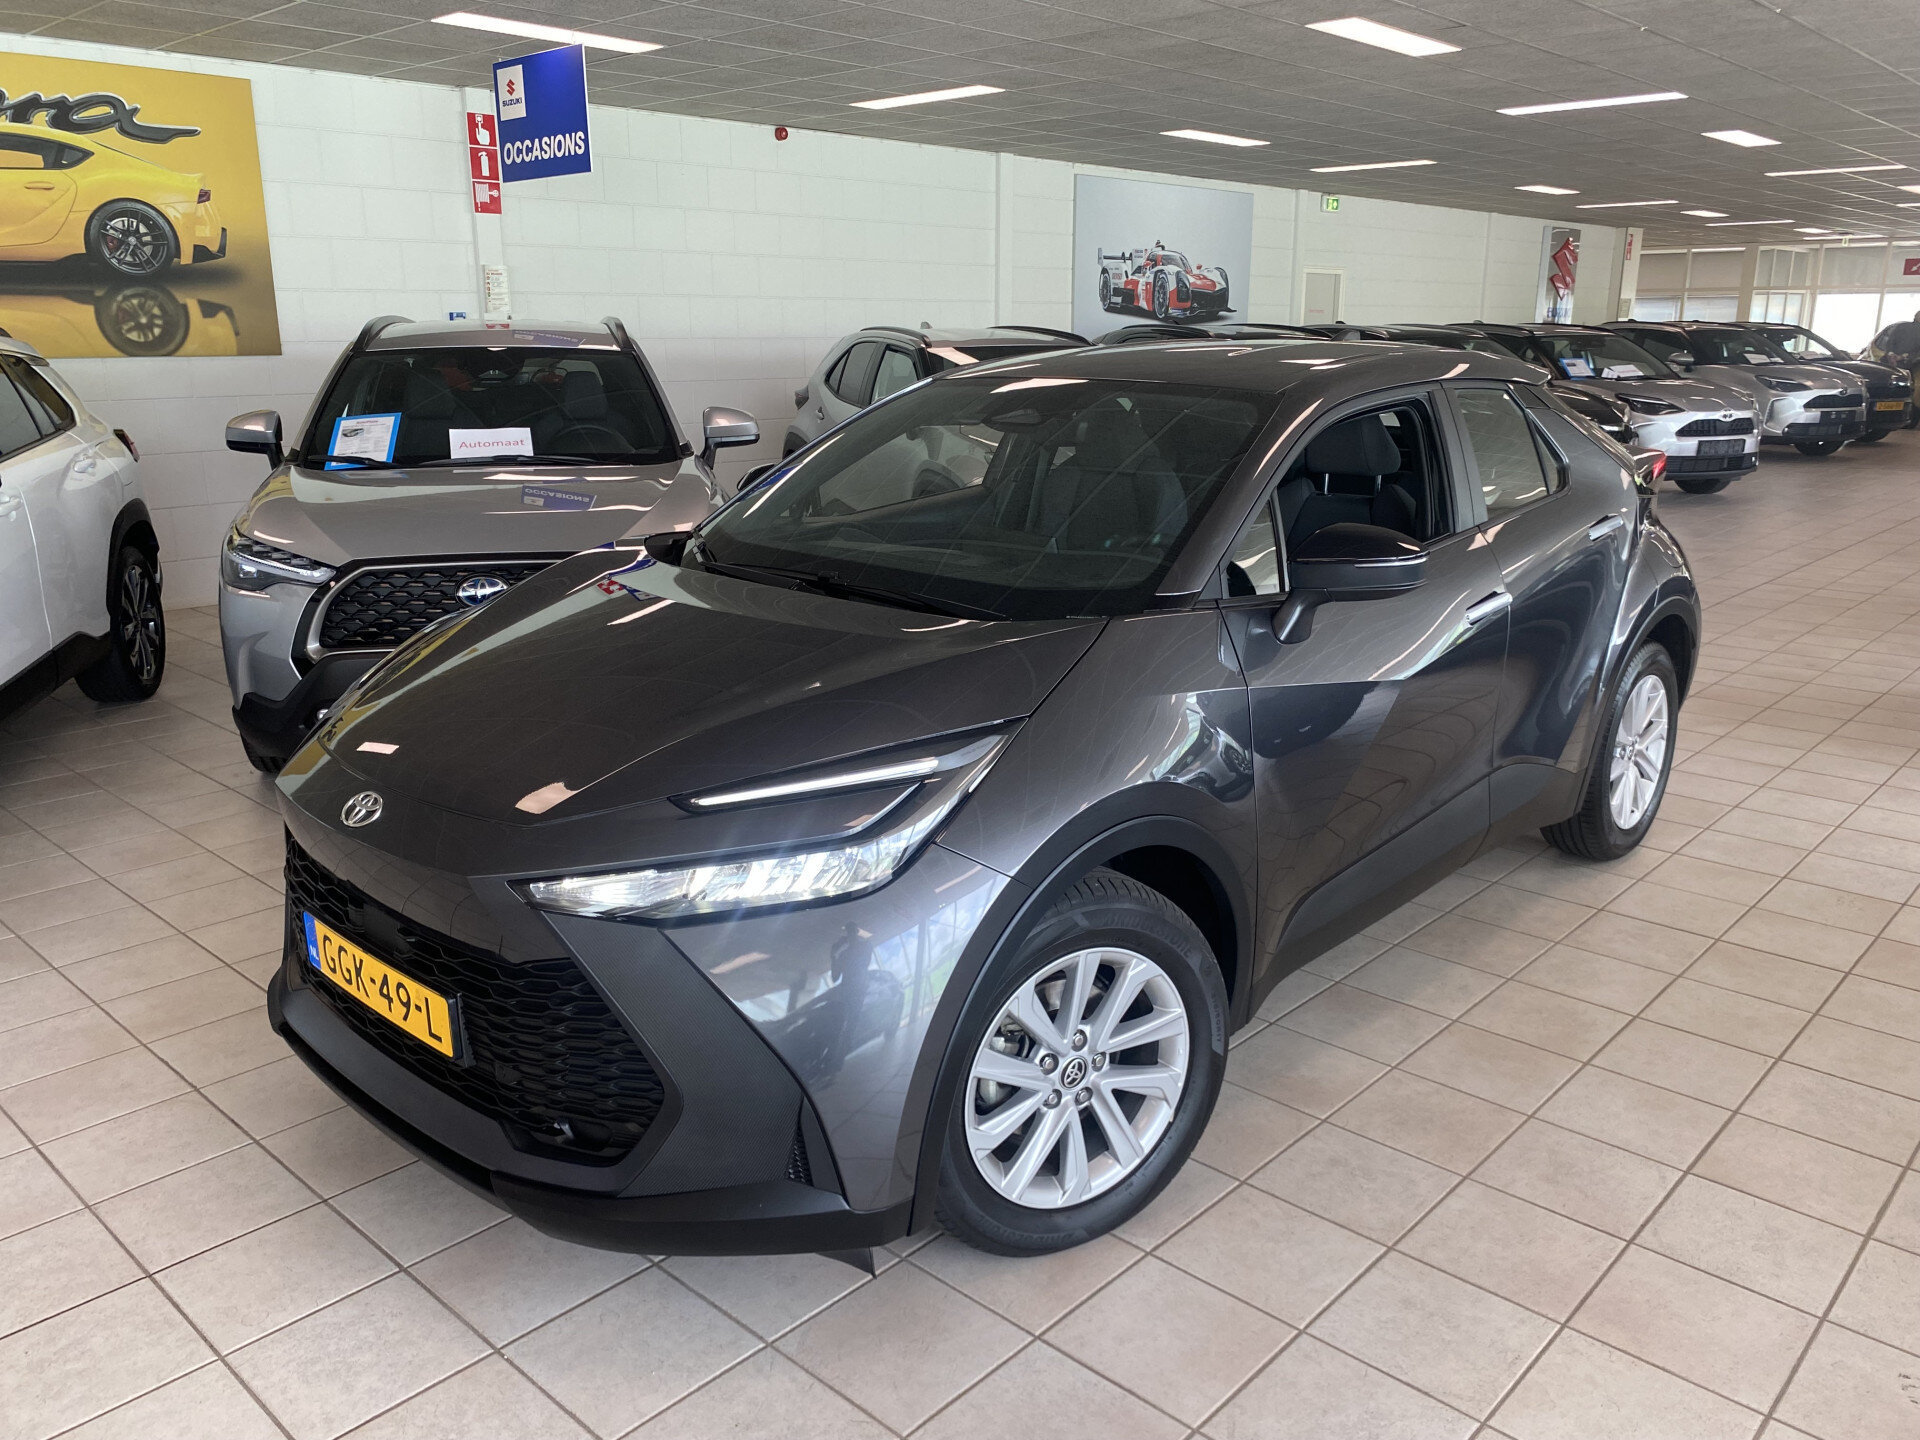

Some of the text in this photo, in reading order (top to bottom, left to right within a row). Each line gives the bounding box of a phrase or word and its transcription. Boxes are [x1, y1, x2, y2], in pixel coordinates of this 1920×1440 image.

[502, 97, 523, 107] SUZUKI
[504, 131, 585, 165] OCCASIONS
[459, 439, 525, 449] Automaat
[310, 945, 319, 961] NL
[322, 934, 443, 1044] GGK-49-L
